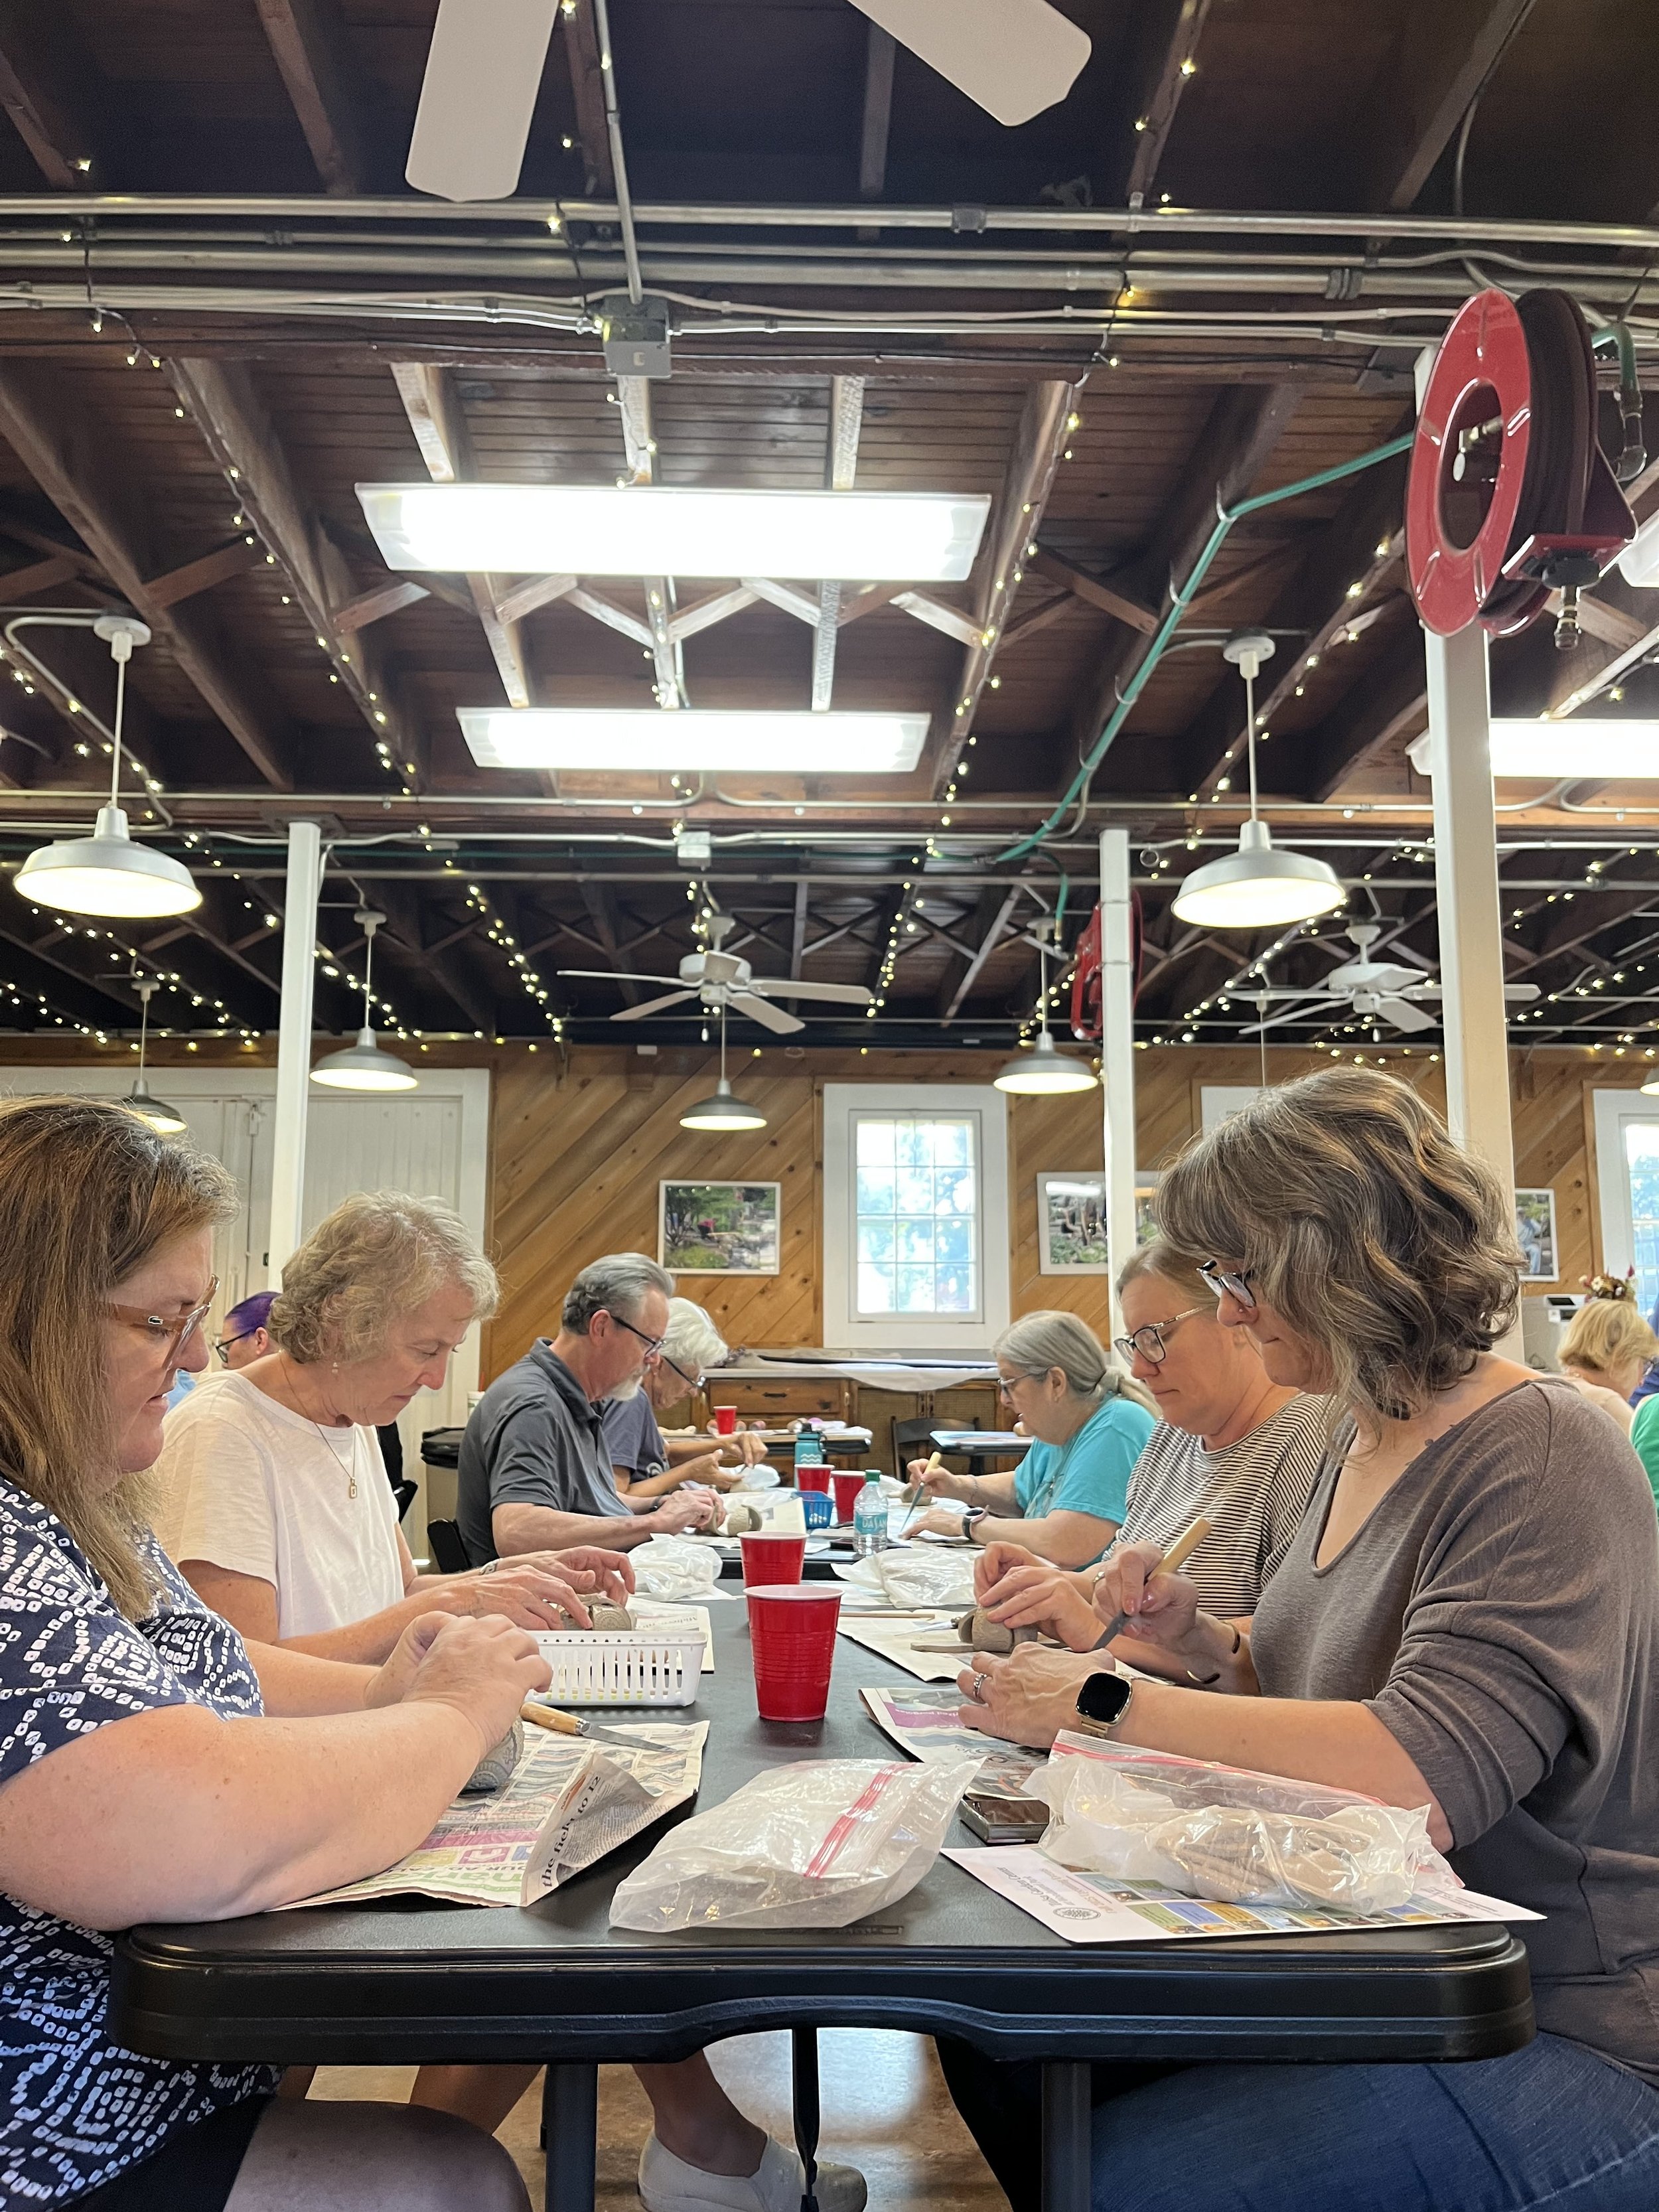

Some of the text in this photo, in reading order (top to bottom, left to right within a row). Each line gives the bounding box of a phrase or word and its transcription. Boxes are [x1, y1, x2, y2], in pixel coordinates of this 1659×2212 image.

[862, 1516, 887, 1530] DASAN
[541, 1858, 555, 1887] the
[578, 1797, 588, 1813] to
[589, 1776, 601, 1792] 12
[997, 1867, 1021, 1880] Center
[1018, 1879, 1043, 1895] Garden
